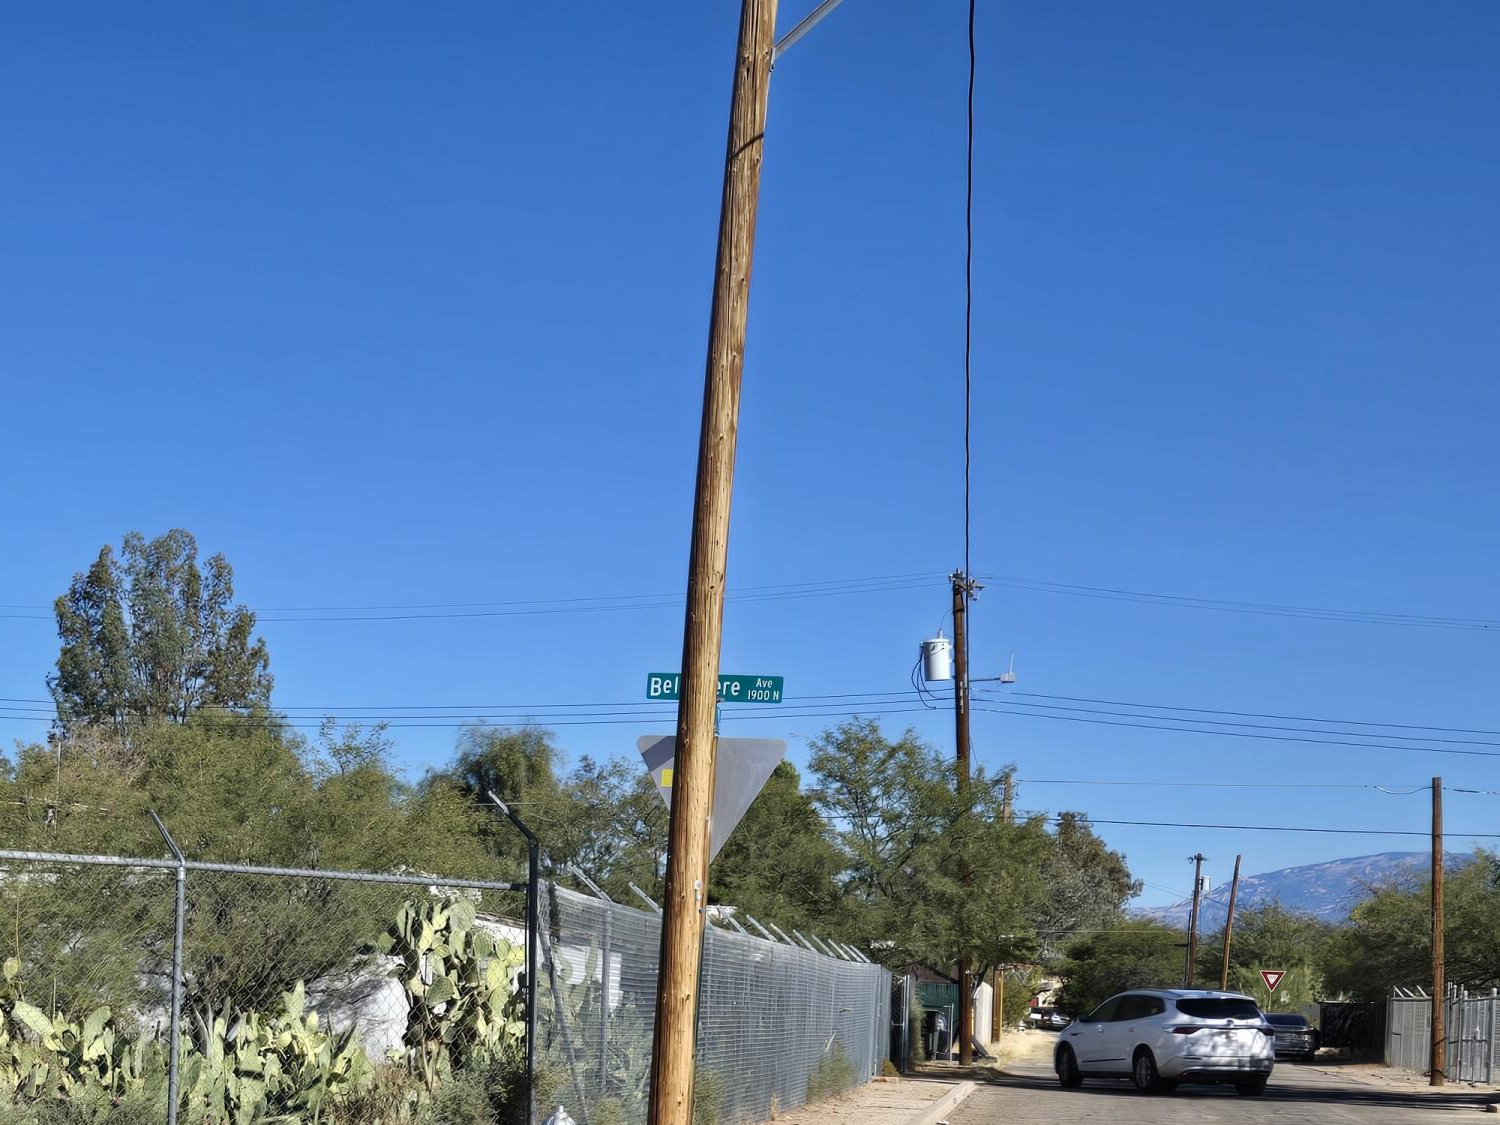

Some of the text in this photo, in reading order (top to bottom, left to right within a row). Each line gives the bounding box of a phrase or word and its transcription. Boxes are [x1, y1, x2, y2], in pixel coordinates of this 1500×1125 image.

[755, 678, 773, 688] Ave
[747, 689, 780, 701] 1900 N
